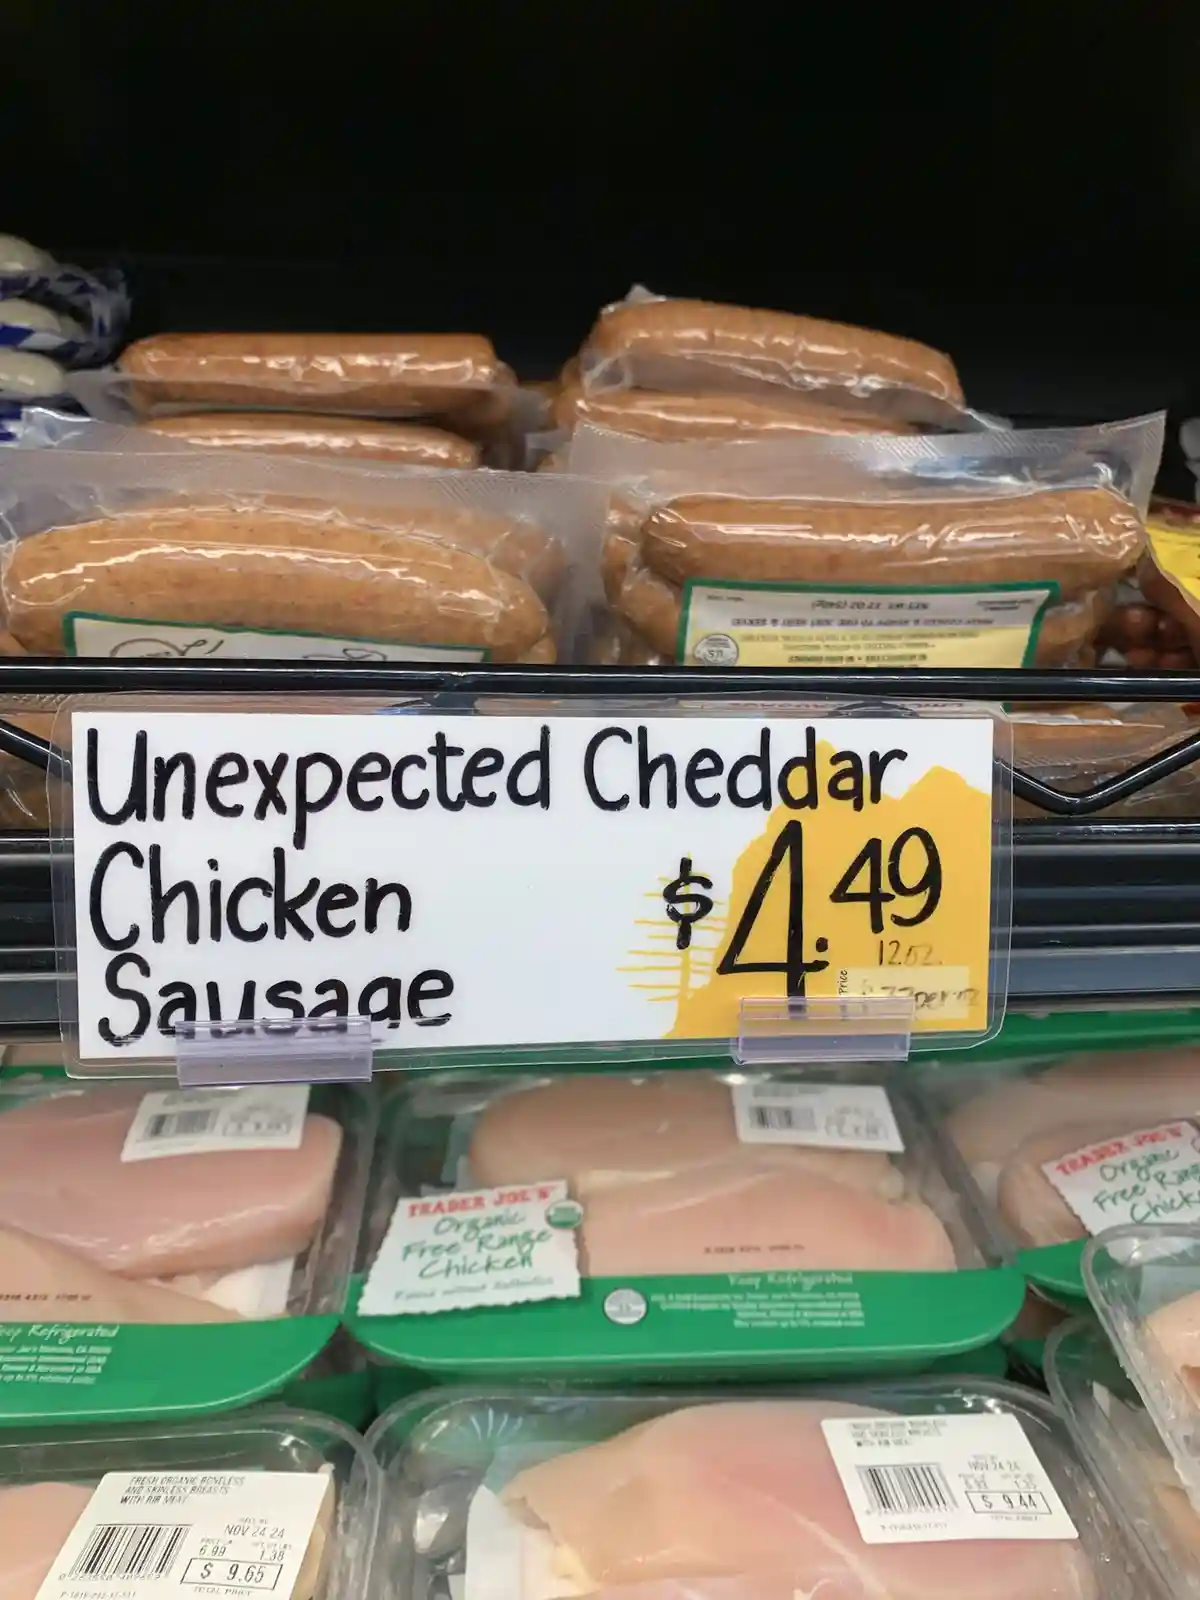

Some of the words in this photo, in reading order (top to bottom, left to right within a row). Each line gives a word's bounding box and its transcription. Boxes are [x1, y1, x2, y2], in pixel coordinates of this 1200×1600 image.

[87, 724, 552, 850] Unexpected
[583, 726, 908, 812] Cheddar
[90, 841, 413, 952] Chicken
[98, 952, 454, 1046] Sausage
[1100, 1149, 1180, 1182] Organic
[408, 1196, 485, 1218] TRADER
[1092, 1183, 1146, 1213] Free
[434, 1208, 526, 1242] Organic
[402, 1240, 462, 1261] Free
[477, 1229, 553, 1256] Range
[418, 1254, 533, 1280] Chicken
[28, 1323, 120, 1345] Refrigerated
[225, 1523, 250, 1537] NOV
[251, 1526, 267, 1538] 24
[268, 1527, 285, 1539] 24
[200, 1562, 215, 1580] $
[226, 1563, 267, 1584] 9.65
